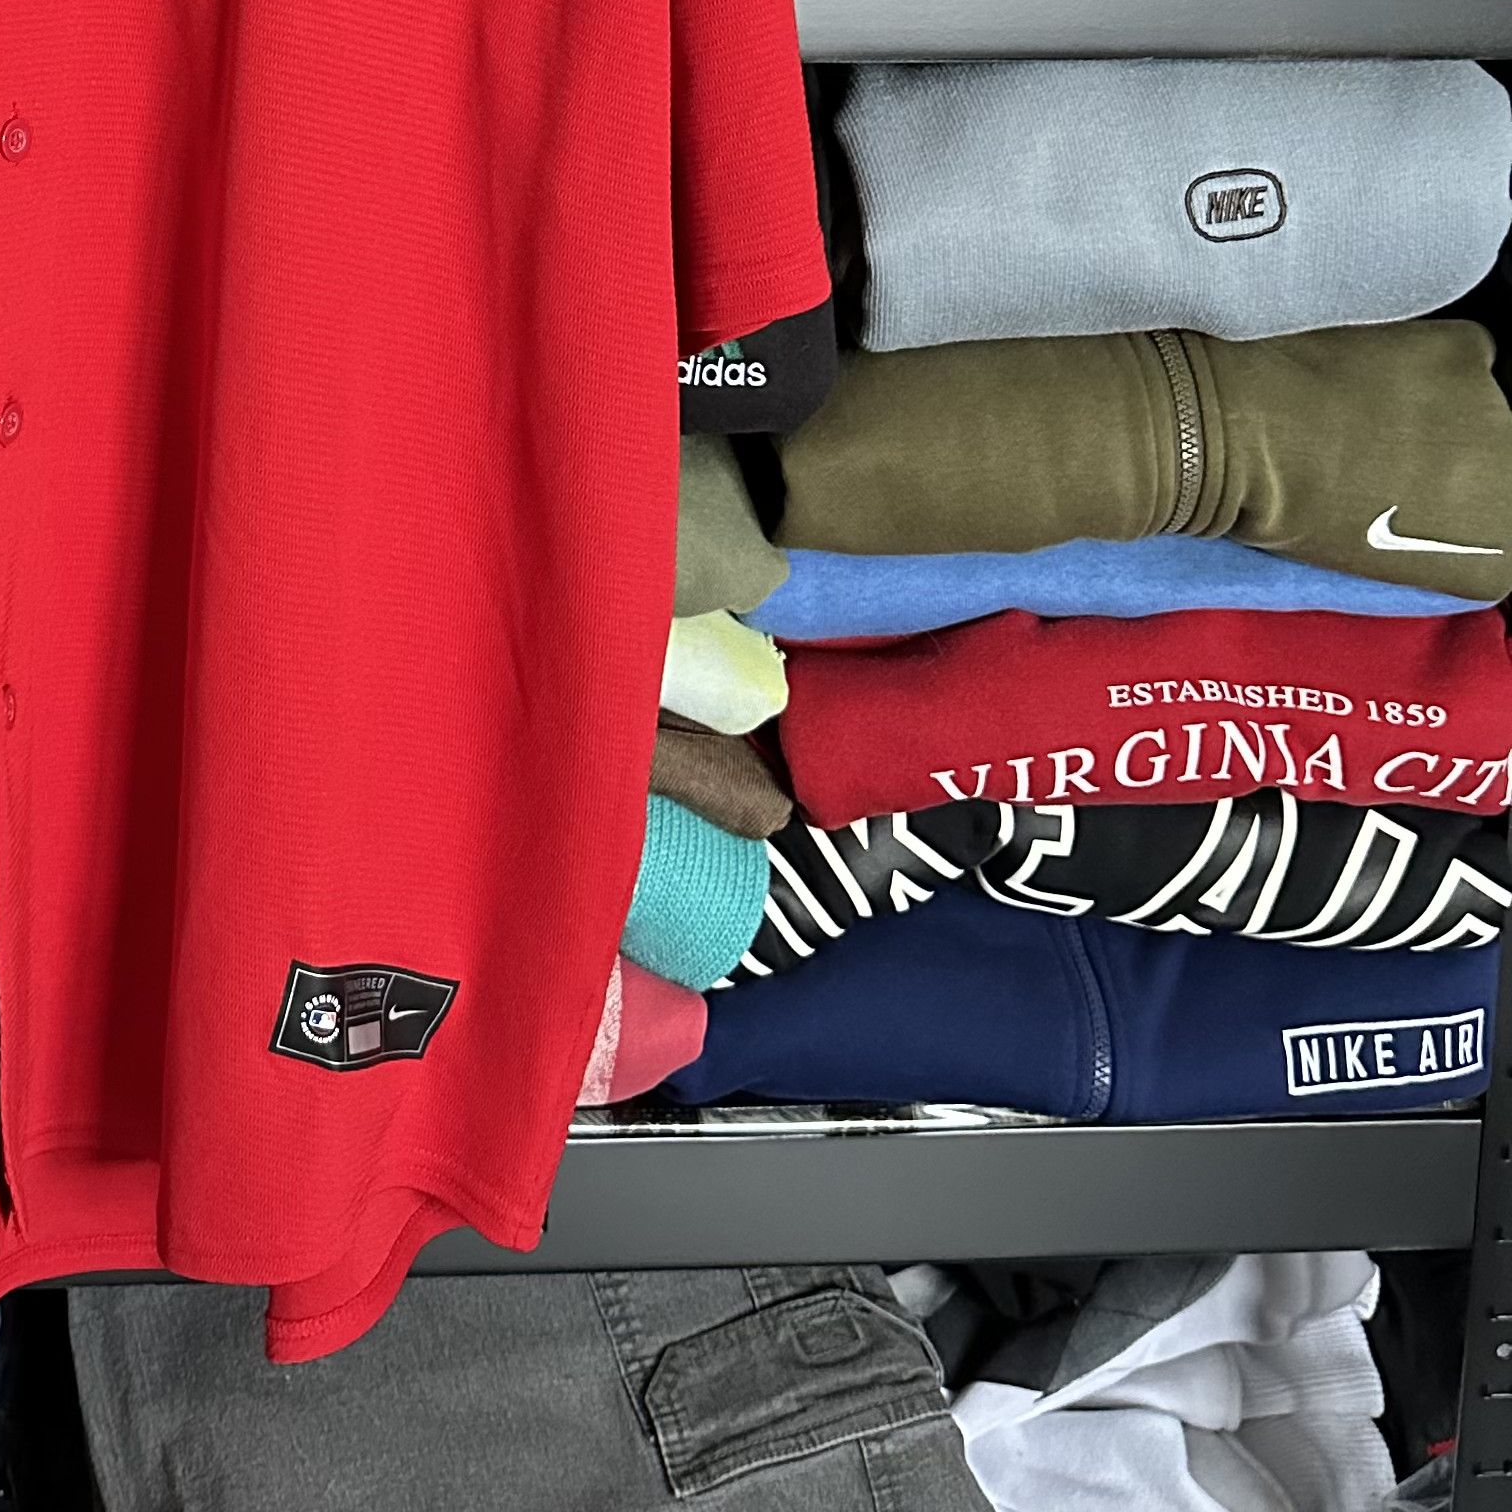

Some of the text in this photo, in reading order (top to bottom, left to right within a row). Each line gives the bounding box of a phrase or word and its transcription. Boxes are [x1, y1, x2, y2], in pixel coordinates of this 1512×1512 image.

[1206, 186, 1268, 224] NIKE
[1108, 679, 1448, 729] ESTABLISHED 1859
[930, 720, 1347, 804] VIRGINIA
[1299, 1023, 1474, 1083] NIKE AIR
